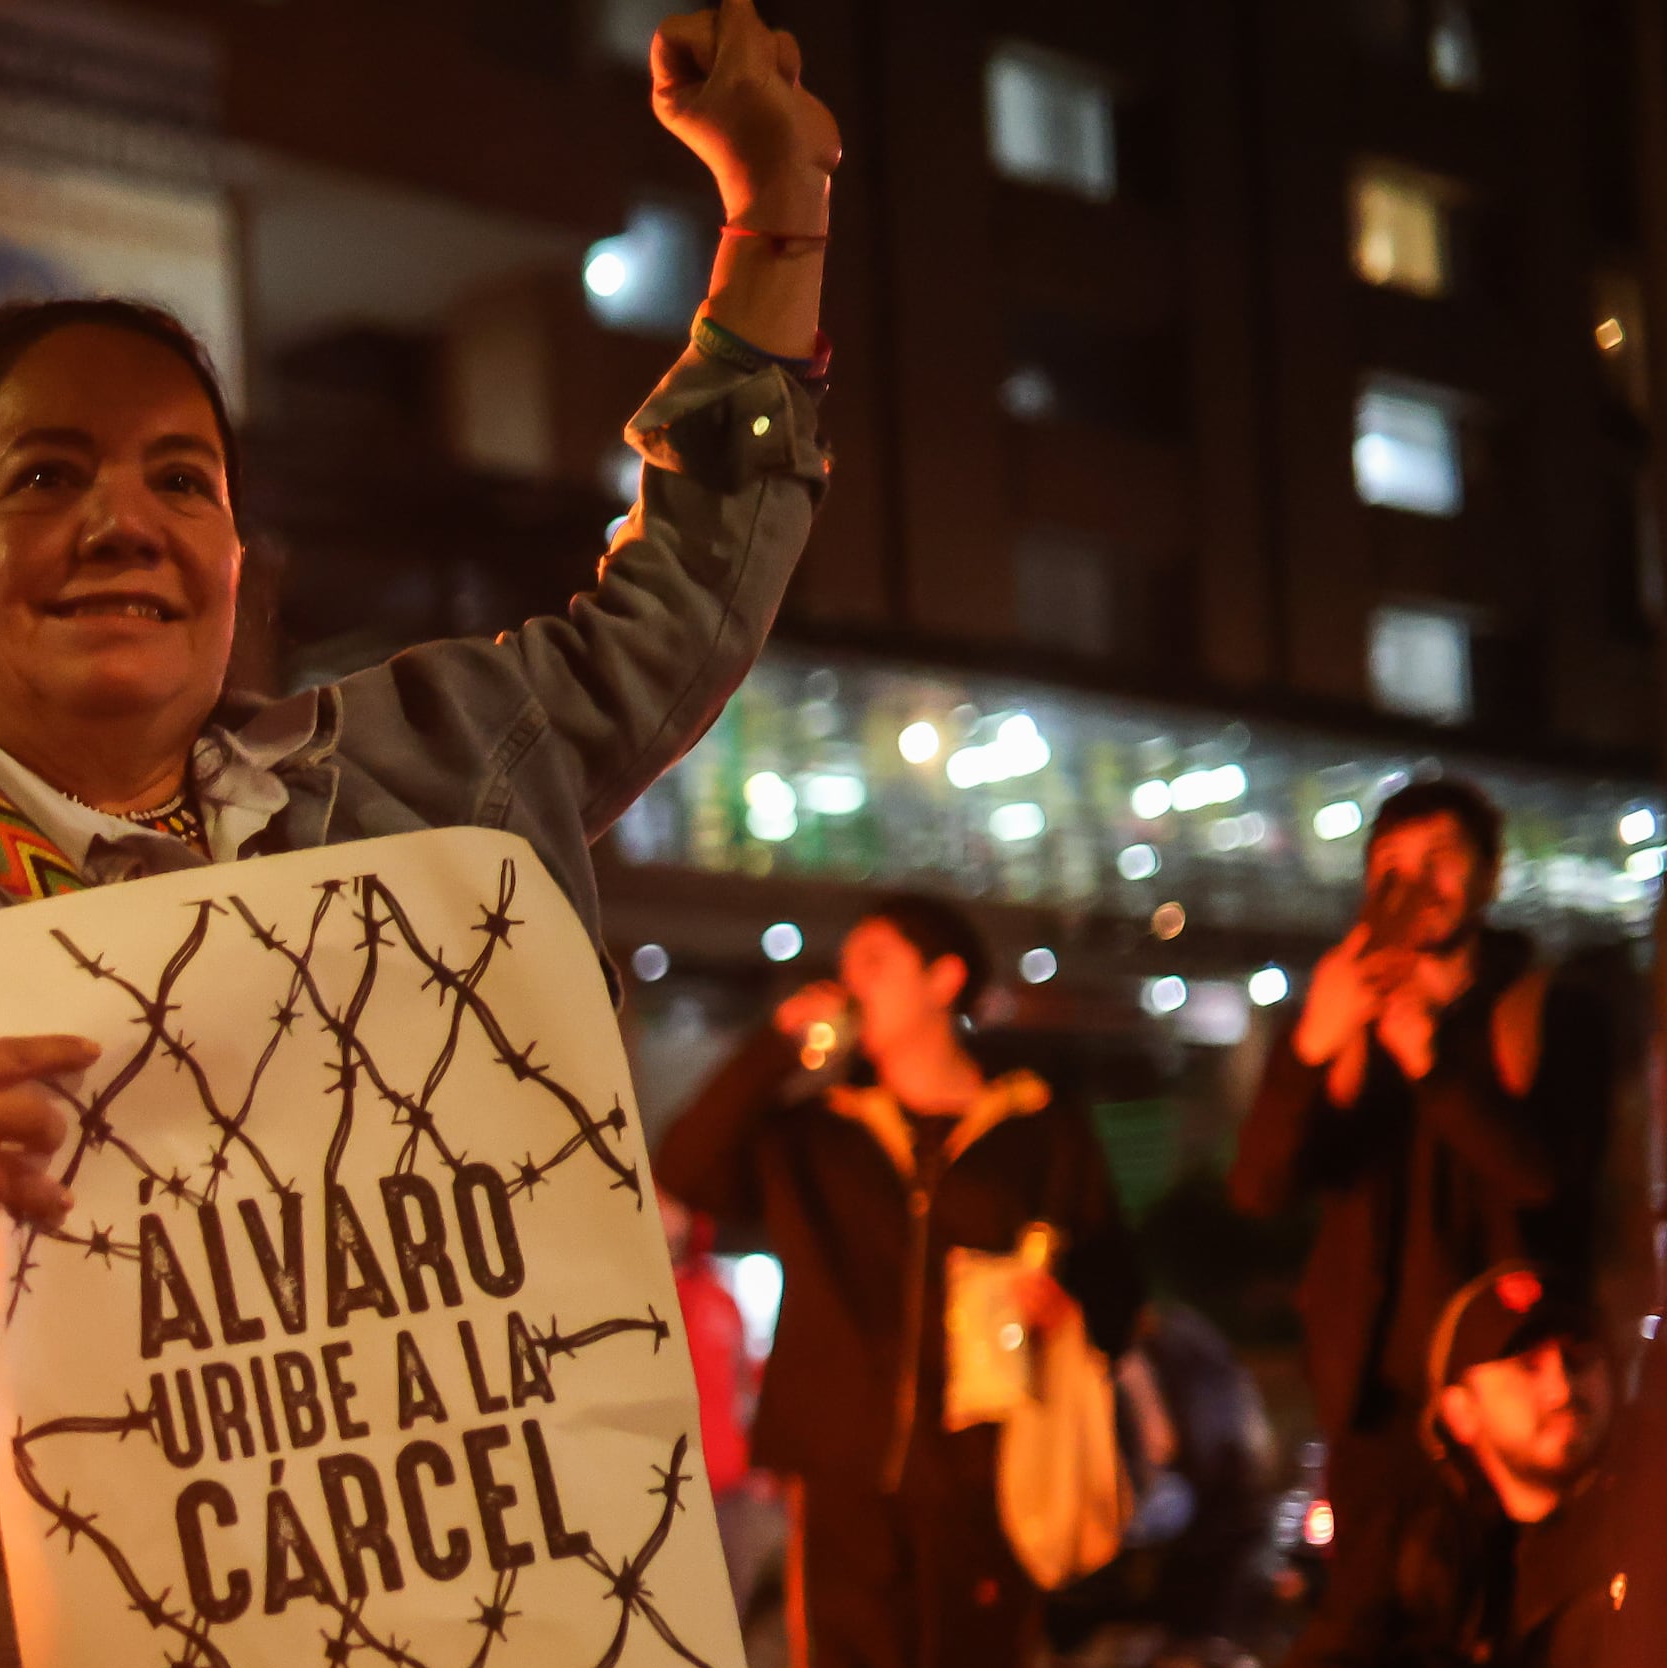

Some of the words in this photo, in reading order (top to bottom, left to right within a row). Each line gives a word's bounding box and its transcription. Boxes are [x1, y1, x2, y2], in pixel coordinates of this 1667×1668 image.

[138, 1163, 526, 1360] ÁLVARO
[150, 1342, 371, 1469] URIBE
[397, 1330, 448, 1431] A
[457, 1311, 557, 1415] LA
[175, 1419, 593, 1625] CÁRCEL
